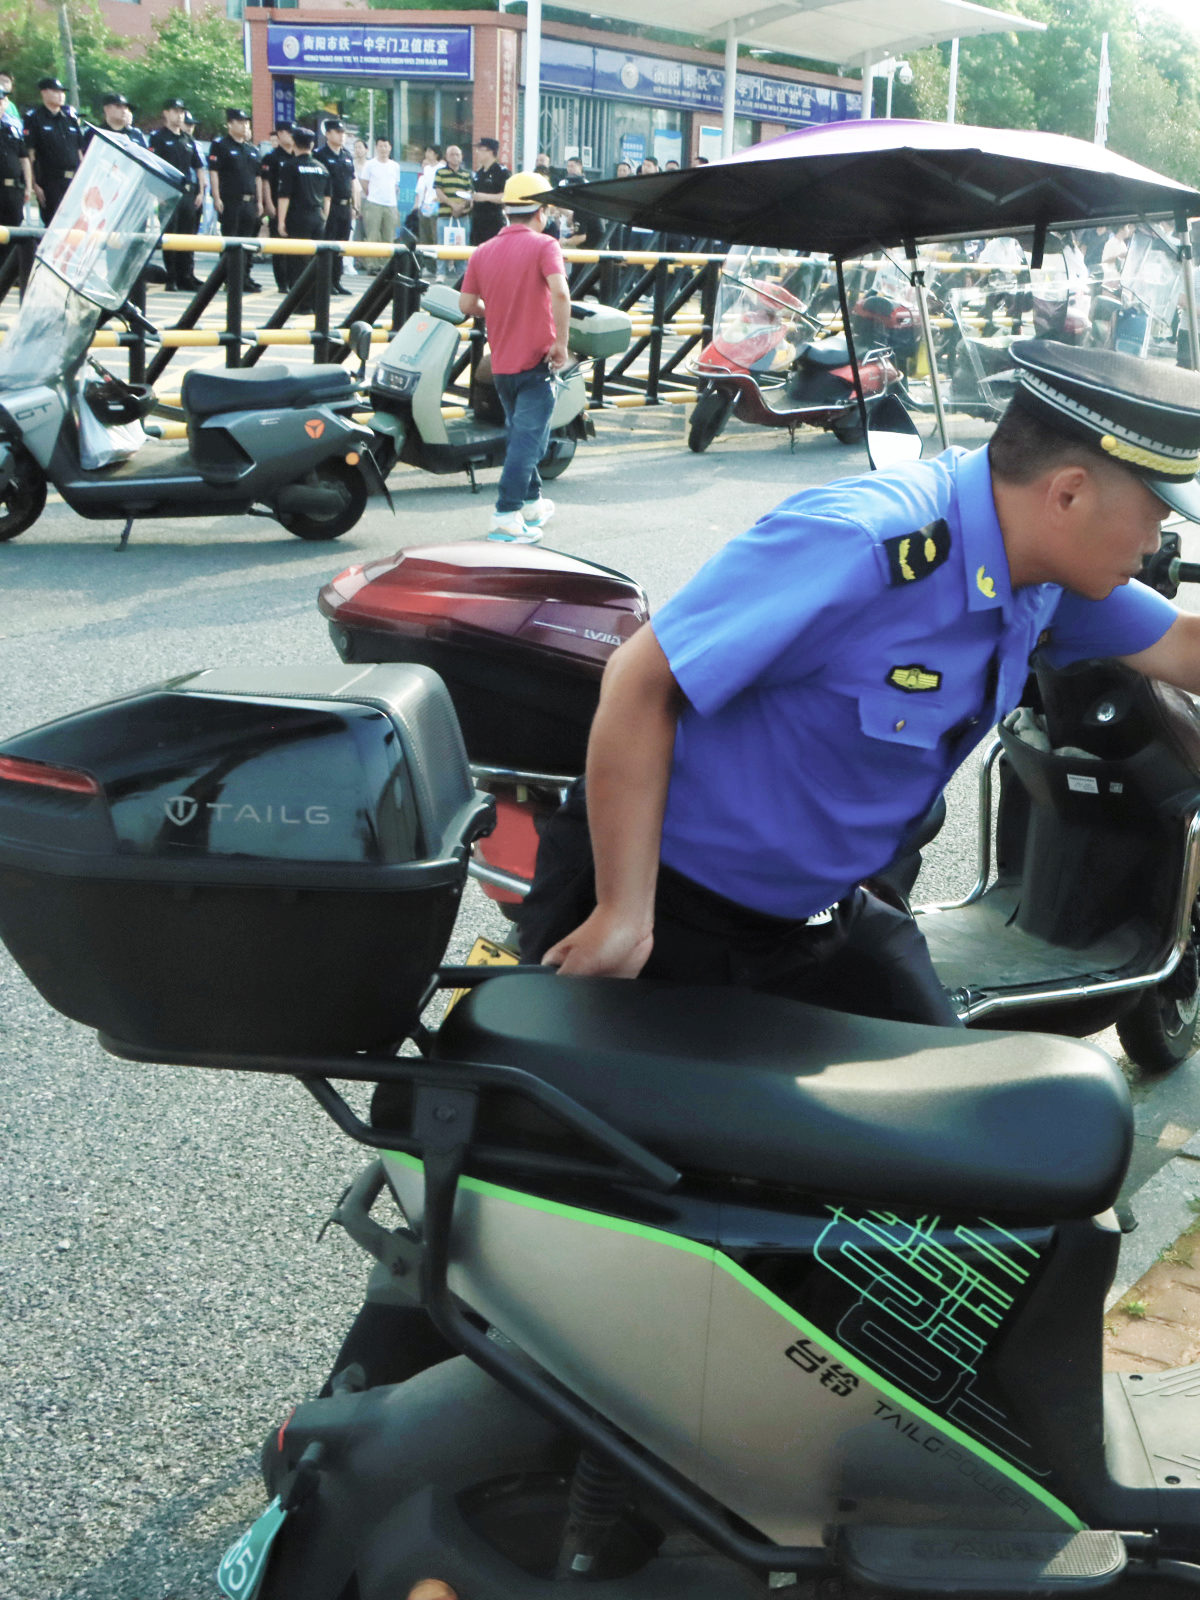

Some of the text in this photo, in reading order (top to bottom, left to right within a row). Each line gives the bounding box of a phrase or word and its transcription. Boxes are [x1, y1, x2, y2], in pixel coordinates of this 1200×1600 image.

[303, 35, 449, 54] 衡阳市铁一中学门卫值班室
[205, 802, 331, 825] TAILG
[784, 1338, 861, 1397] 台铃
